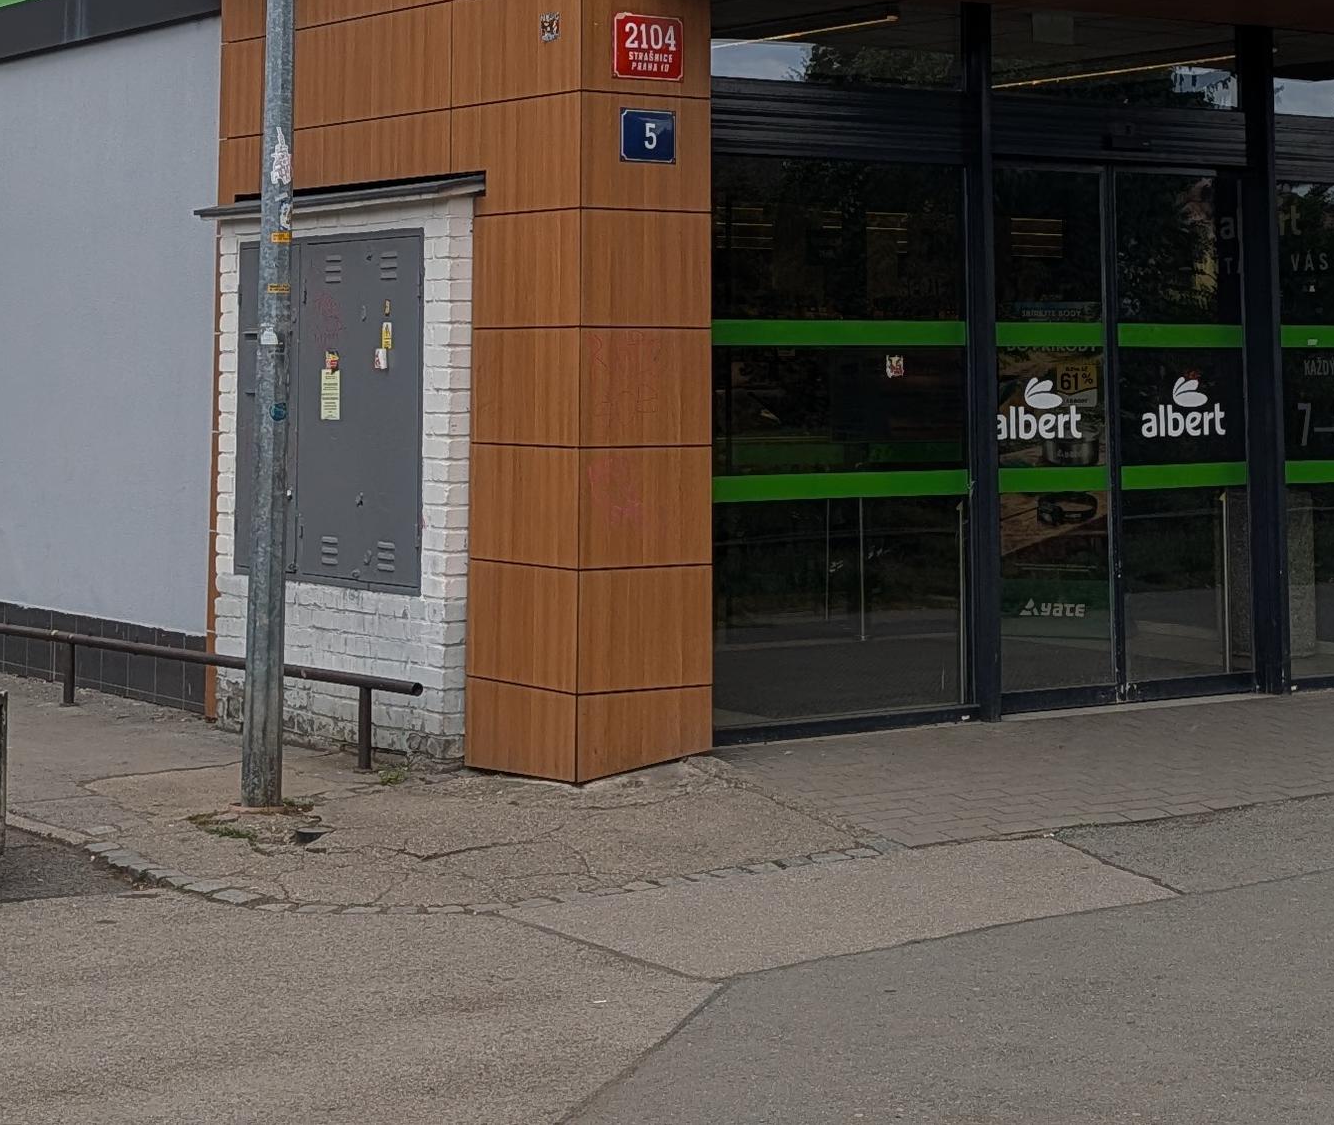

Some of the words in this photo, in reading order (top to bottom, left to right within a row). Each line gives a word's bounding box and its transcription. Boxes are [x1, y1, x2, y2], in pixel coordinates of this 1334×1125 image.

[624, 22, 677, 52] 2104
[628, 50, 673, 63] STRAŠNICE
[631, 62, 658, 72] PRAHA
[660, 63, 670, 73] 10
[644, 122, 657, 150] 5
[996, 405, 1083, 440] albert
[1141, 404, 1226, 438] albert
